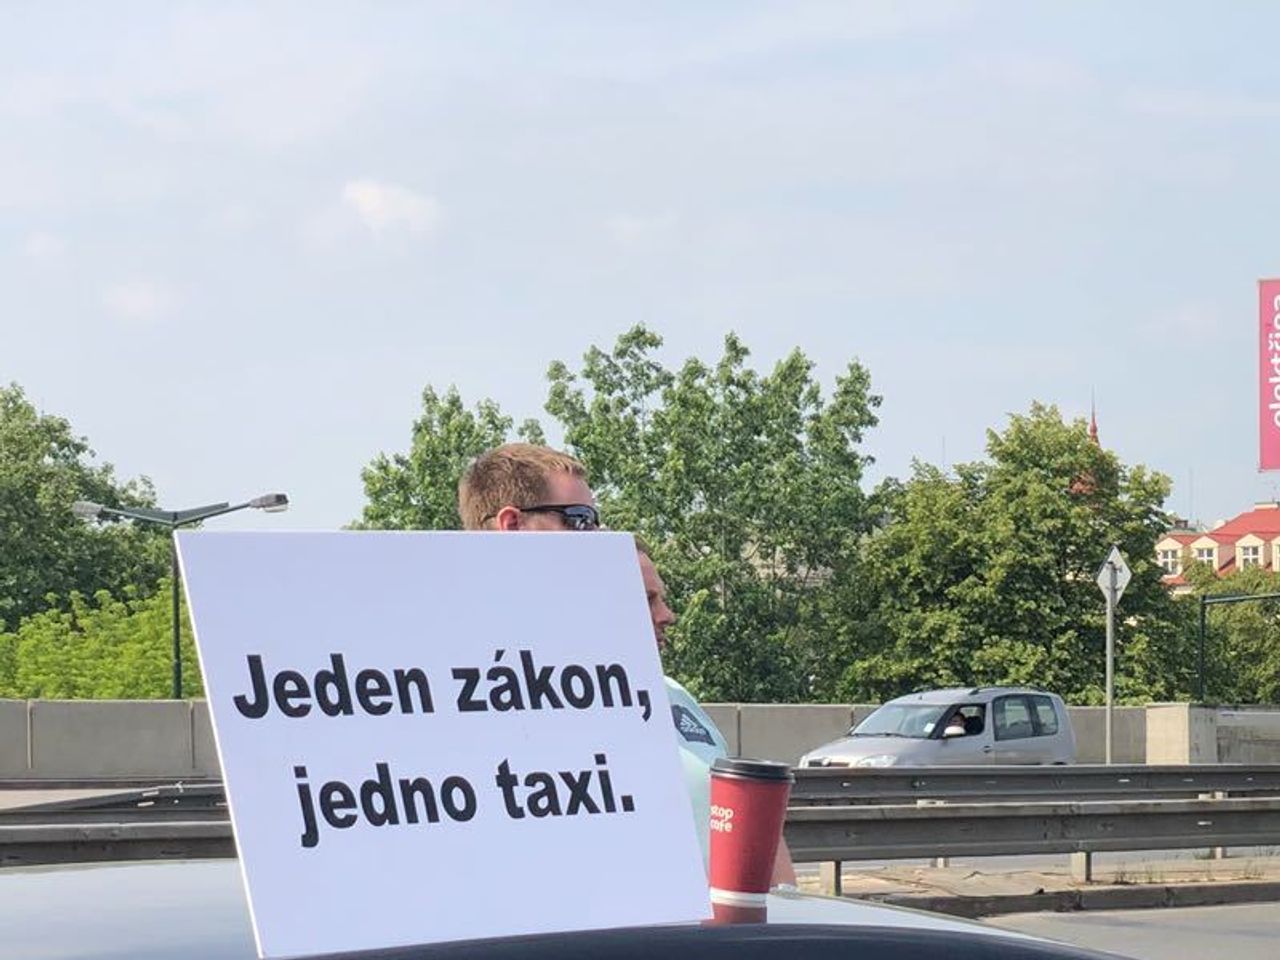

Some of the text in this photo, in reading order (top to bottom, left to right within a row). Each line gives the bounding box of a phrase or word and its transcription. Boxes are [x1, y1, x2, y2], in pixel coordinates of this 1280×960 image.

[233, 649, 652, 722] Jeden zákon,
[293, 753, 636, 848] jedno taxi.
